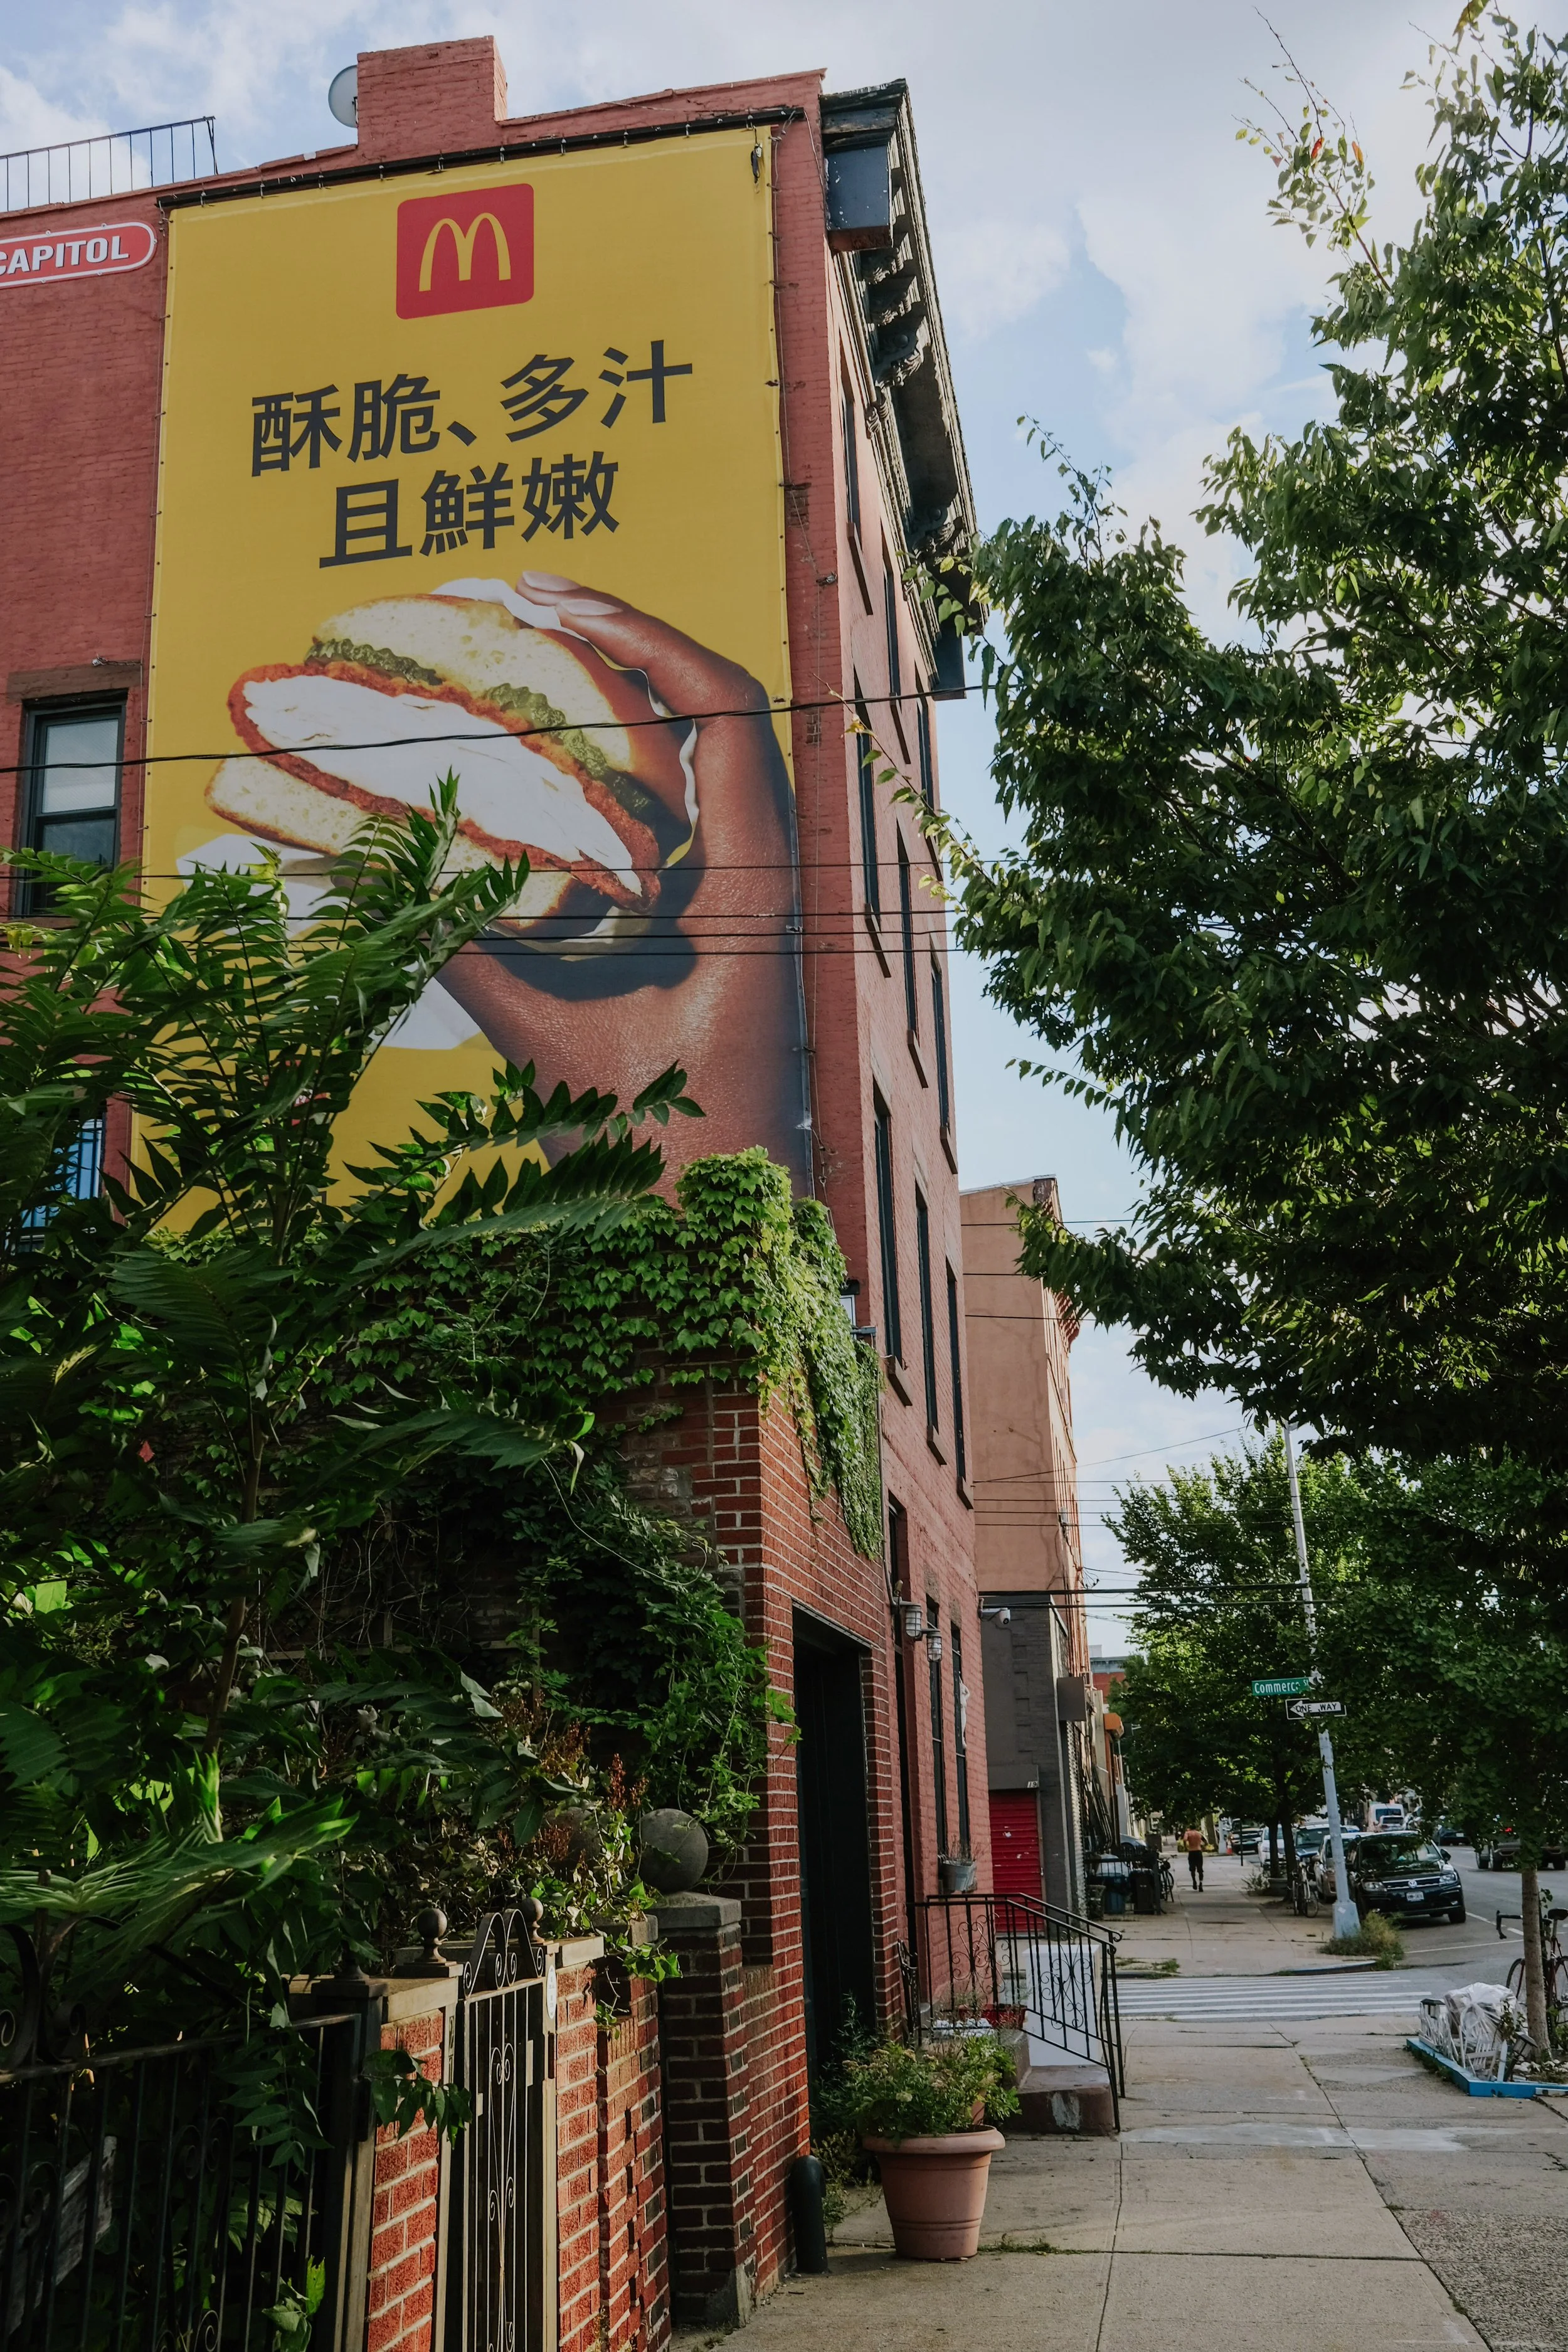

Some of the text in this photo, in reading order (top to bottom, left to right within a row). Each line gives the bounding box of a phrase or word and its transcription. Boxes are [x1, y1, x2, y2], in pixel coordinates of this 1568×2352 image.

[251, 339, 693, 477] 酥脆、多汁
[319, 451, 620, 568] 且鮮嫩
[1296, 1702, 1337, 1714] ONE WAY
